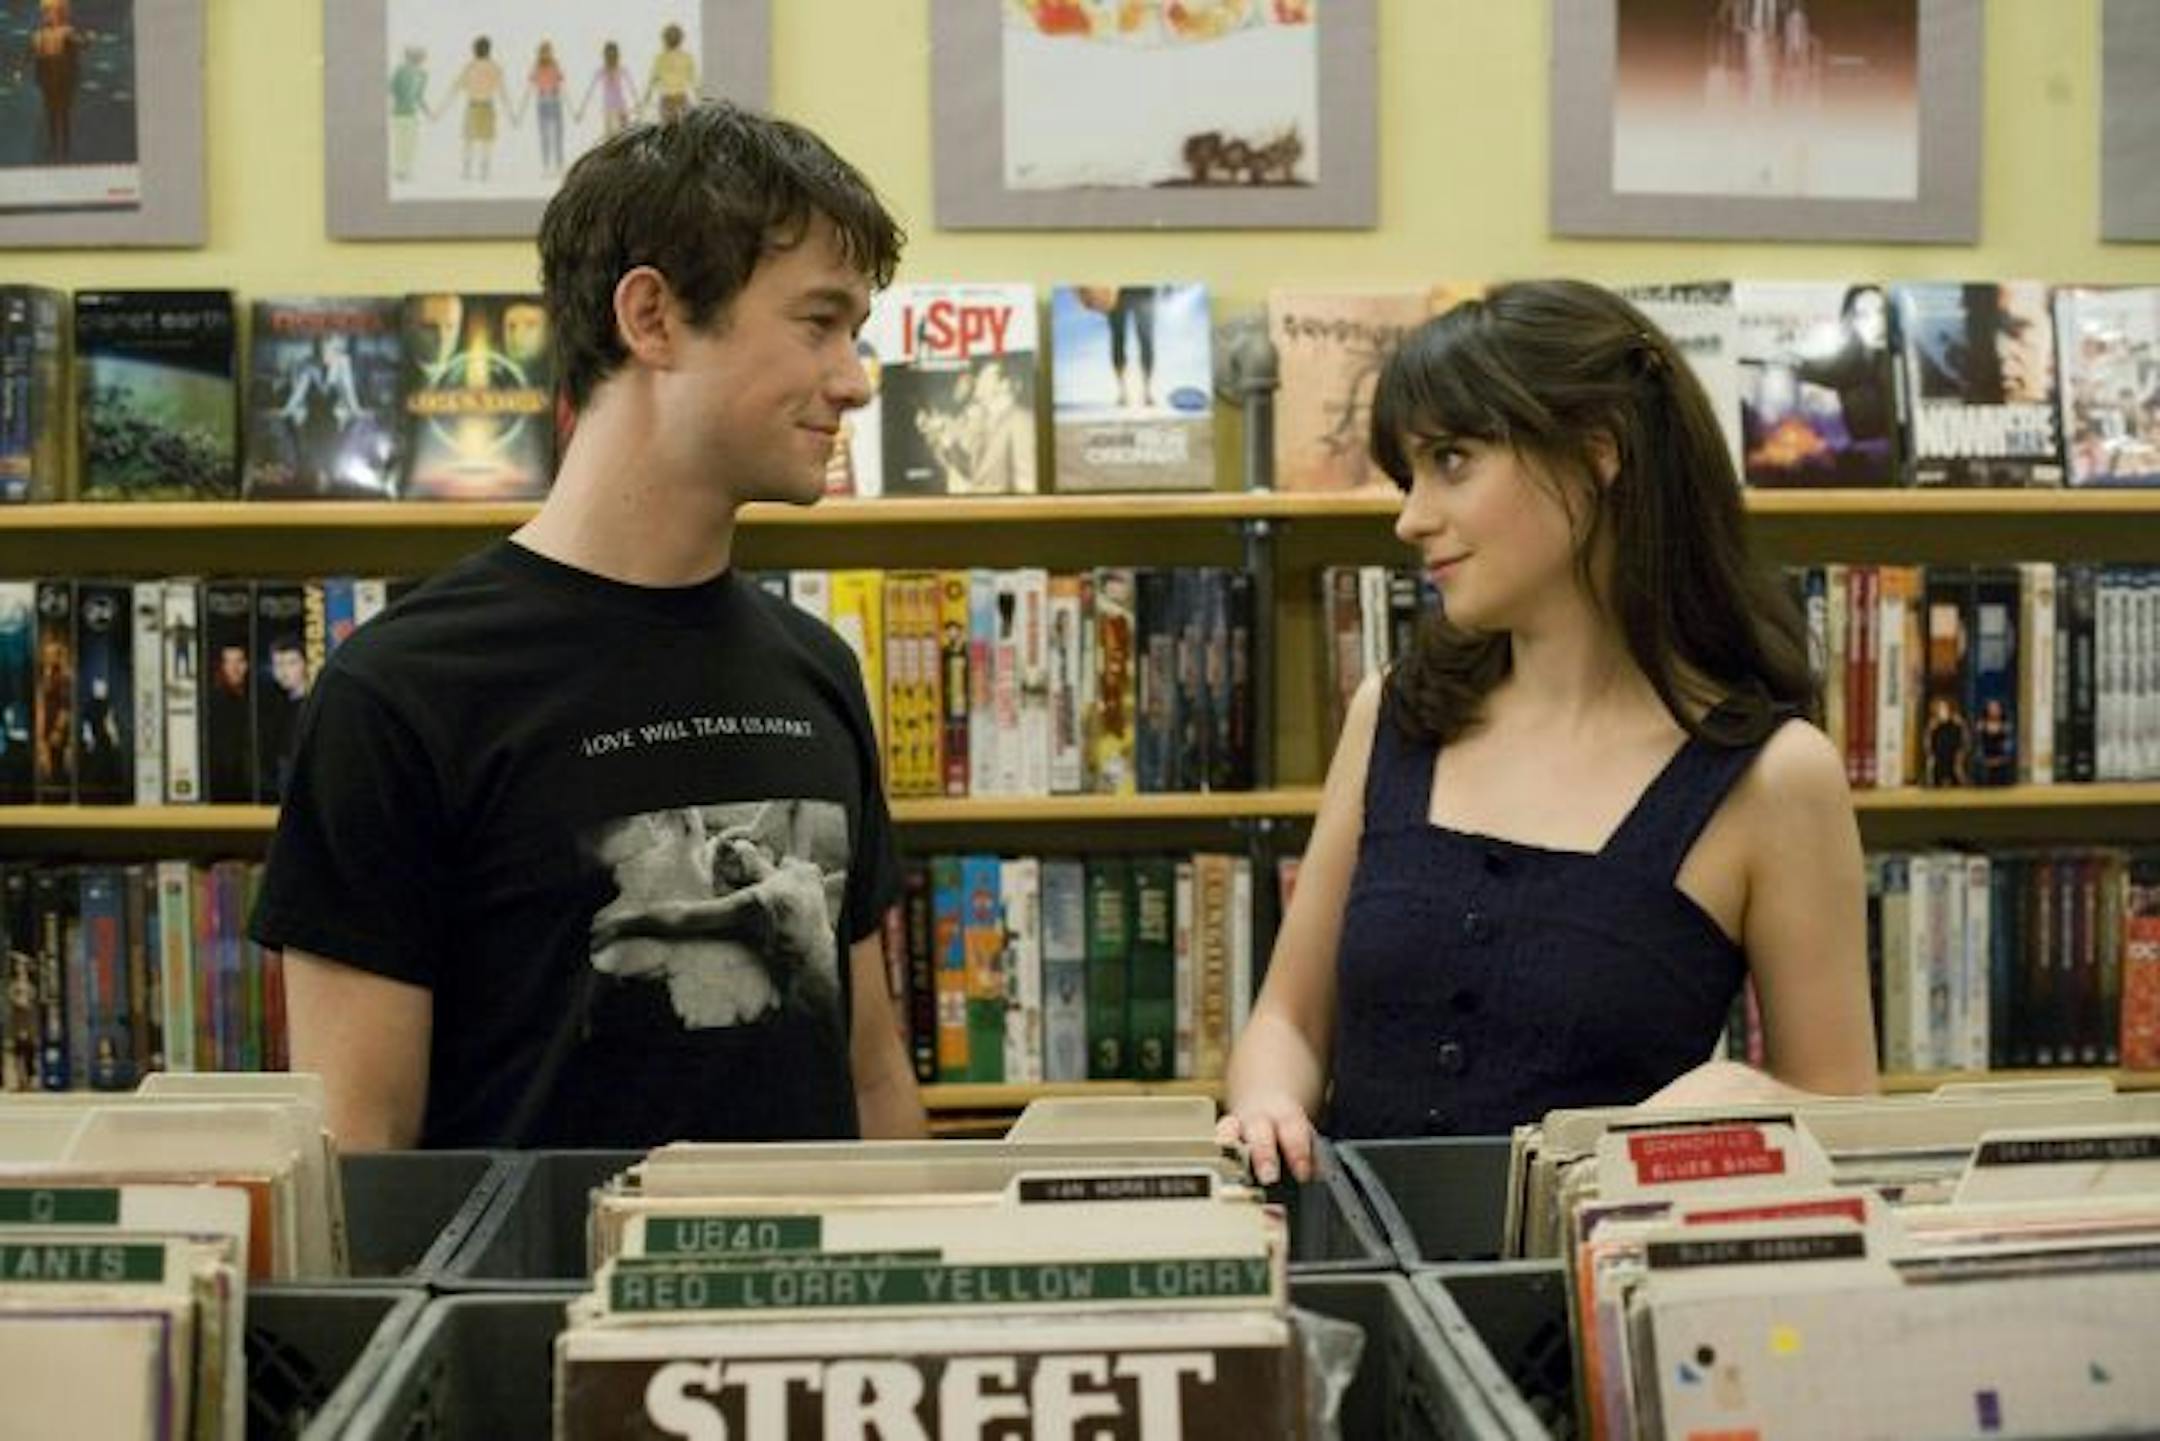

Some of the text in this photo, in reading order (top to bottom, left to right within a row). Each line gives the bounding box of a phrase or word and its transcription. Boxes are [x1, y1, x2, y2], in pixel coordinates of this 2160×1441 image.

[903, 300, 1012, 358] I SPY
[580, 728, 635, 757] LOVE
[639, 719, 691, 744] WILL
[691, 716, 740, 738] TEAR
[675, 1219, 780, 1250] UB40
[0, 1247, 126, 1280] ANTS
[742, 1269, 887, 1306] LORRY
[922, 1265, 1094, 1301] YELLOW
[1129, 1261, 1268, 1297] LORRY
[646, 1352, 1216, 1441] STREET
